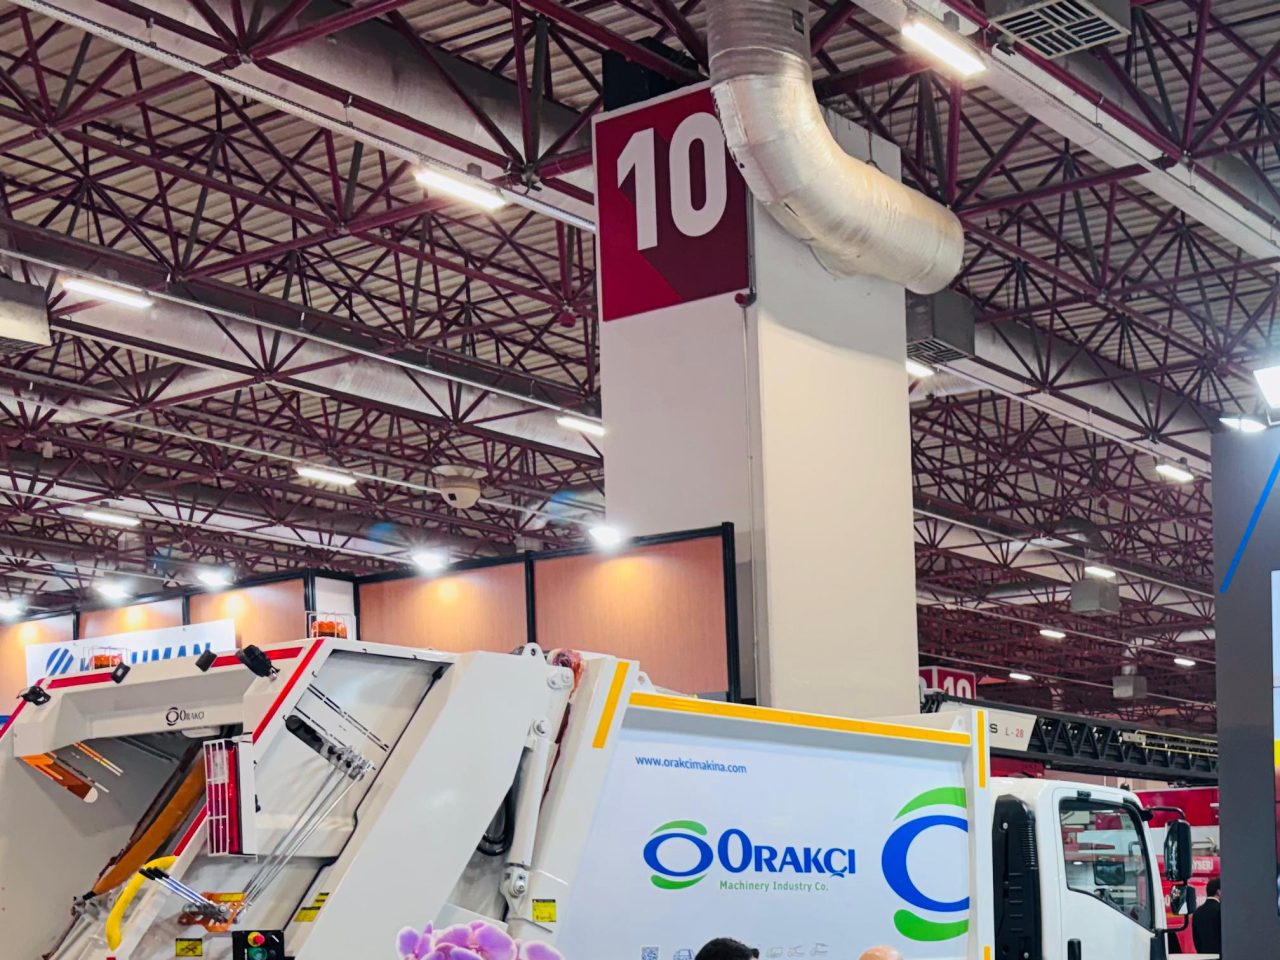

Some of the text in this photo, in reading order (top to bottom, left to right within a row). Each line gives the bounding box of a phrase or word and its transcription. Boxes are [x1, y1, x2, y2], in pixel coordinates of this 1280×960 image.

[617, 111, 728, 251] 10
[635, 755, 748, 775] www.orakcimakina.com
[717, 828, 857, 879] ORAKÇI
[719, 879, 830, 894] Machinery Industry Co.
